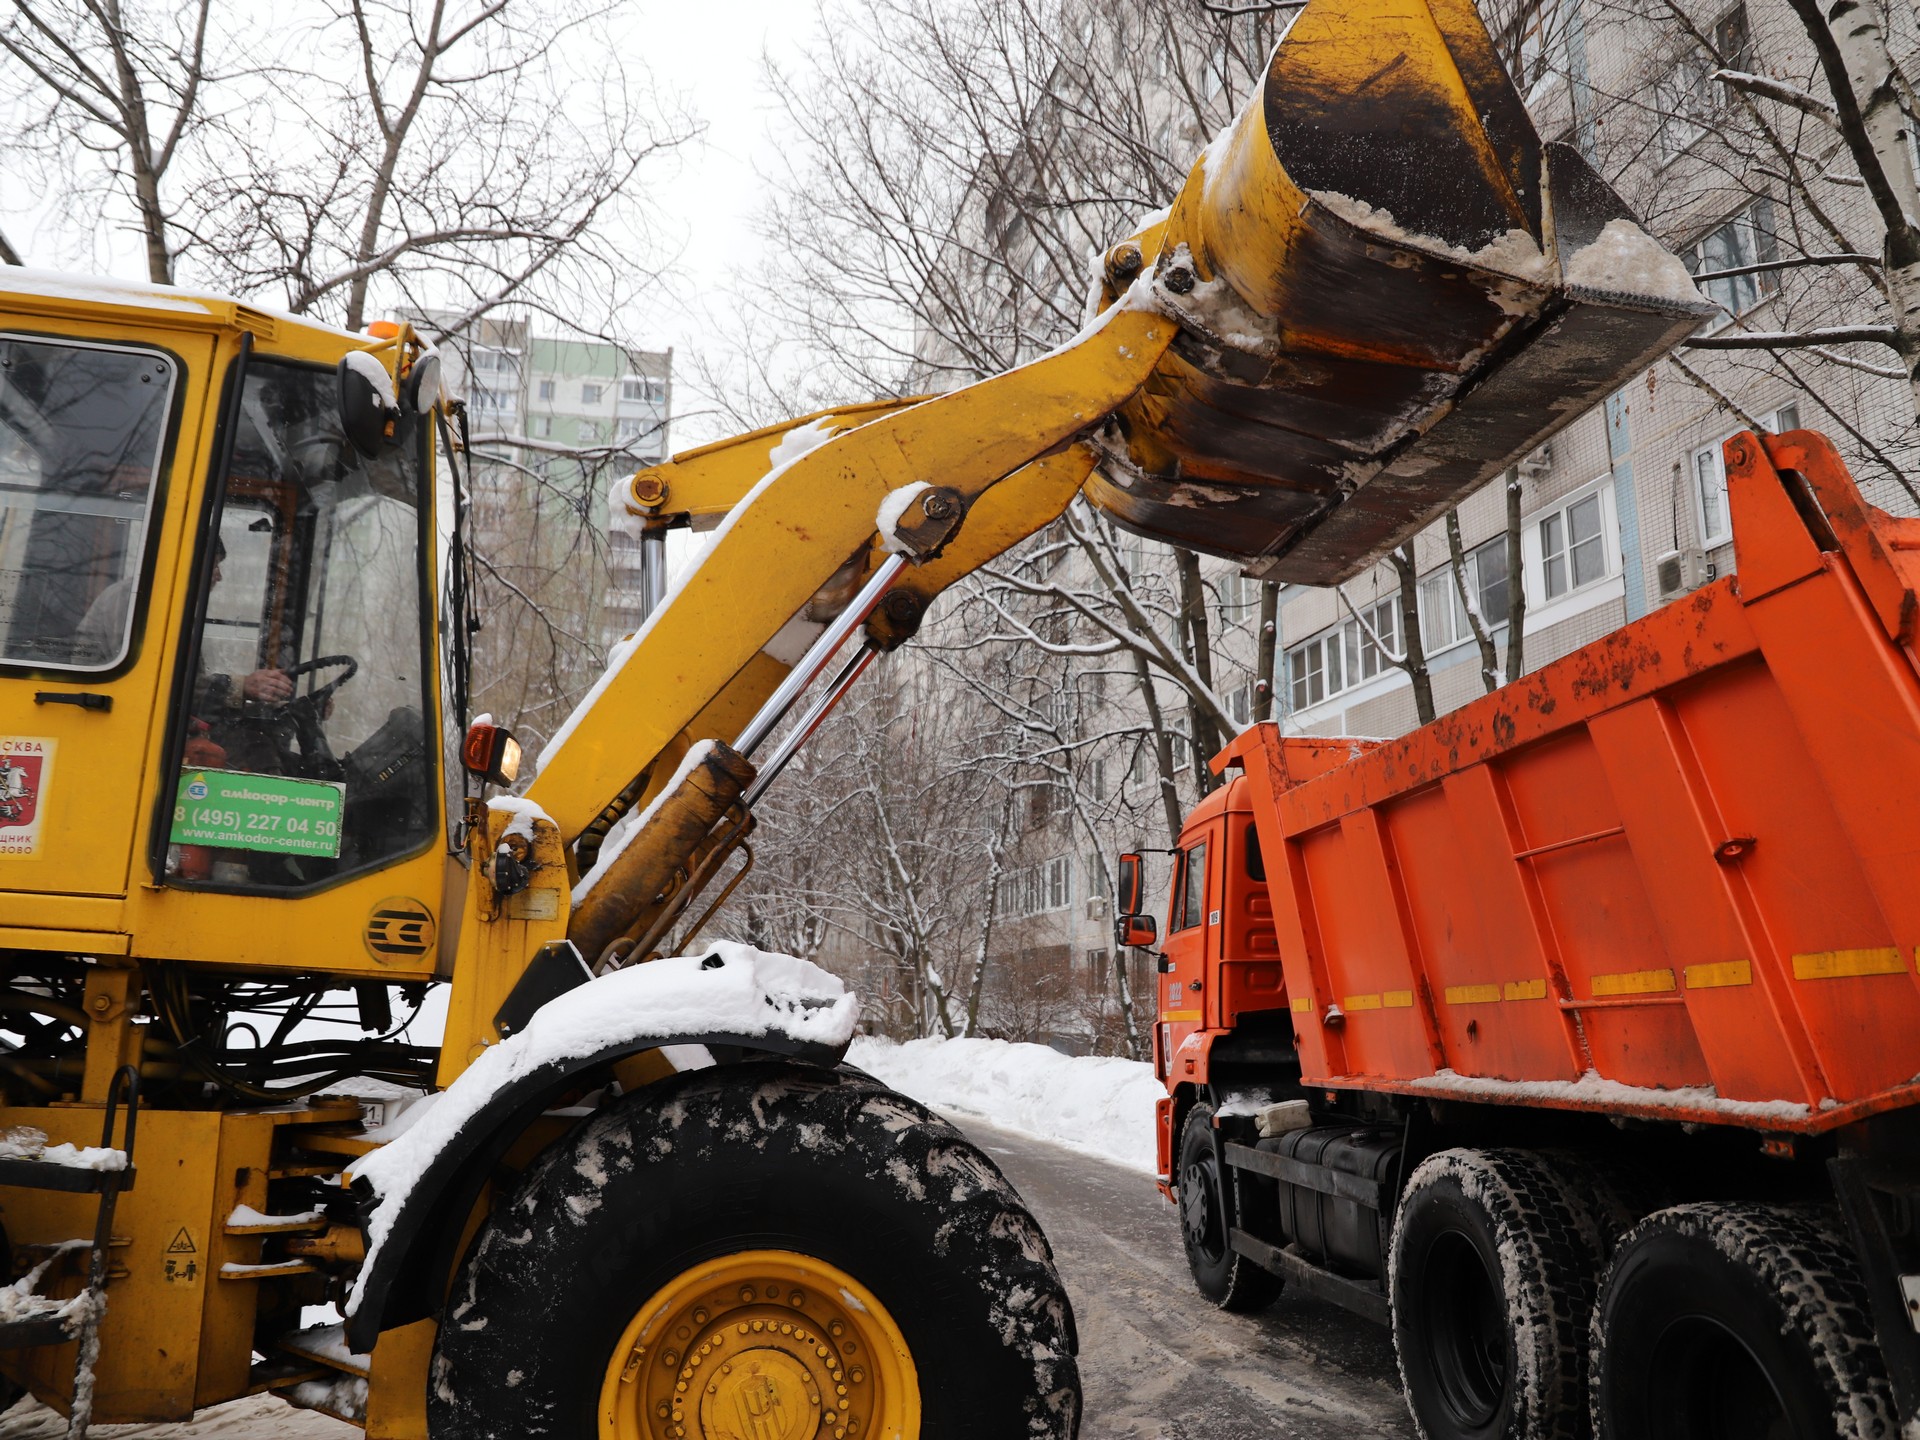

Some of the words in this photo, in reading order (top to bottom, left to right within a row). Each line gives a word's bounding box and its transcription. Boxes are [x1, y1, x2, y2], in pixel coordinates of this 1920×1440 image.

[174, 806, 186, 822] 8
[192, 808, 241, 831] (495)
[246, 813, 281, 830] 227
[287, 818, 309, 833] 04
[315, 820, 337, 836] 50
[183, 829, 333, 850] www.amkodor-center.ru
